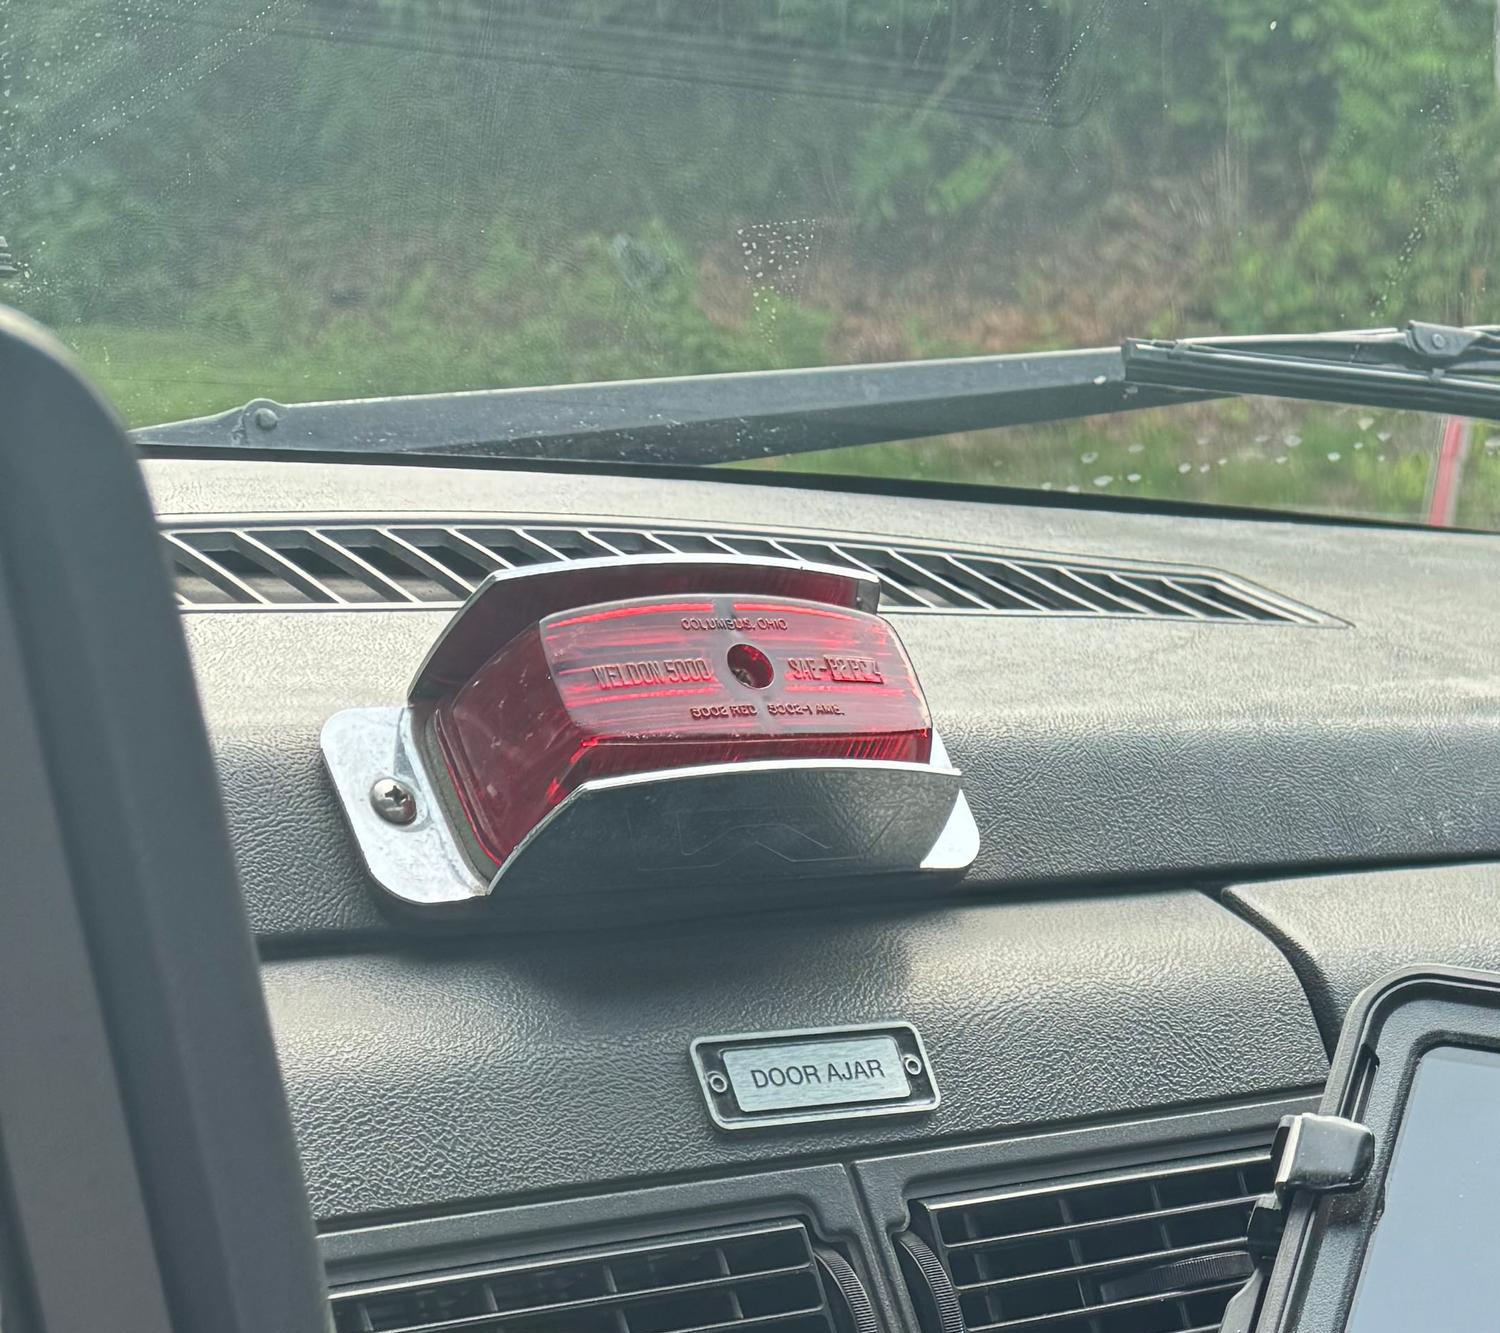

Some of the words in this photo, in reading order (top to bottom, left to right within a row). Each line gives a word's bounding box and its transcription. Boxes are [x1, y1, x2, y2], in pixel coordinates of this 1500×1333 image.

[757, 617, 788, 632] OHIO
[592, 660, 665, 690] WELDON
[665, 656, 715, 684] 5000
[729, 702, 758, 718] RED
[750, 1065, 822, 1089] DOOR
[827, 1059, 886, 1082] AJAR
